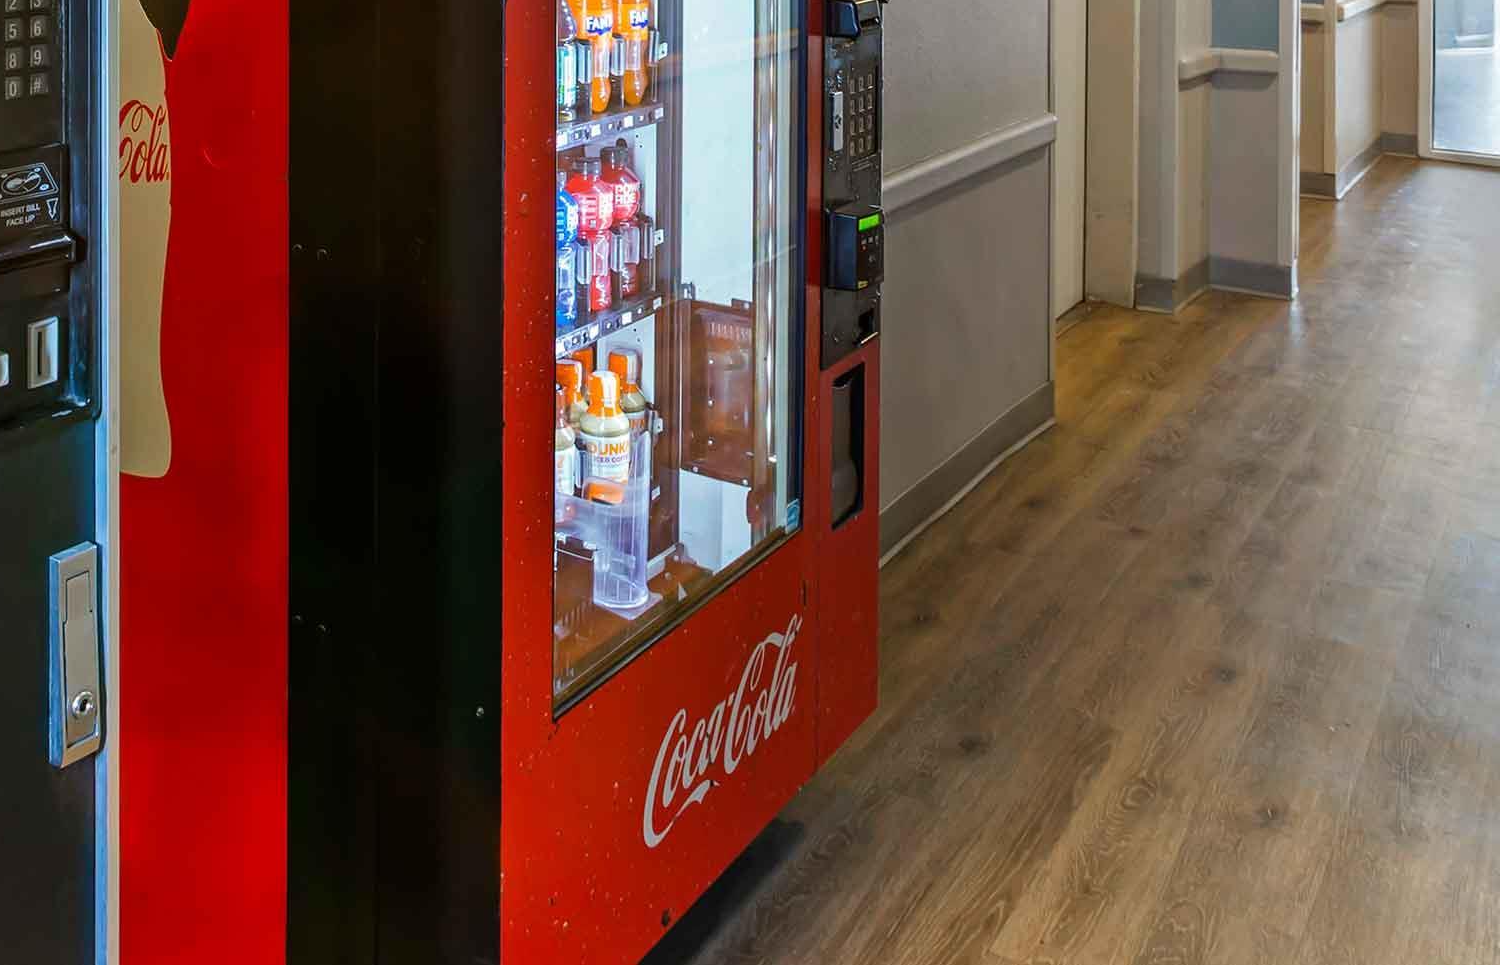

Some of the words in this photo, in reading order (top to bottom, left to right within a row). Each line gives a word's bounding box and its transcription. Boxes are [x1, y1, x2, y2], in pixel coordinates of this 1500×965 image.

[585, 12, 612, 31] FAN
[5, 216, 25, 227] FACE
[25, 214, 36, 224] UP
[586, 441, 629, 455] DUNK
[643, 613, 803, 848] Coca-Cola
